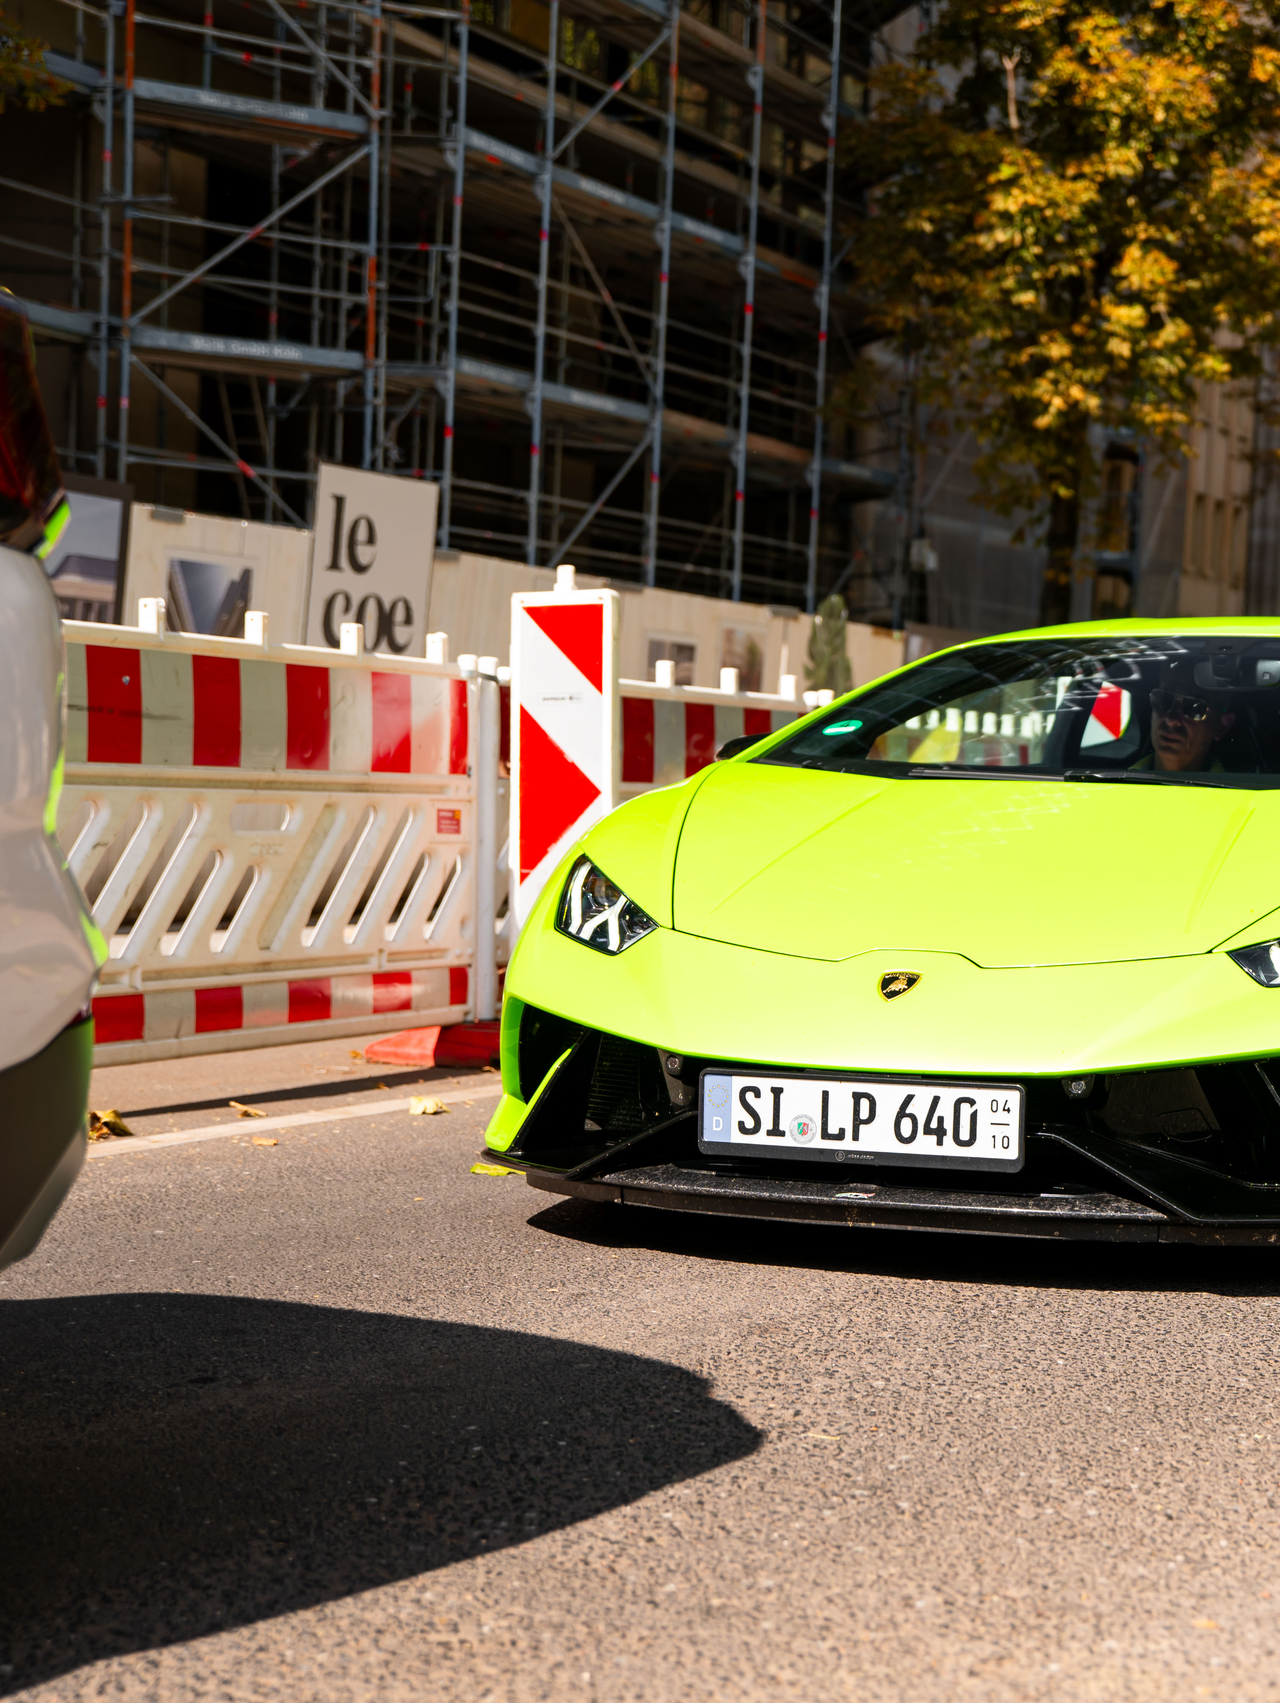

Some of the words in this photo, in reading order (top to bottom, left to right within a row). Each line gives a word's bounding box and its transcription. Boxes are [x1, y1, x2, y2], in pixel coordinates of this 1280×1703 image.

[324, 493, 379, 576] le
[990, 1099, 1011, 1114] 04
[712, 1116, 723, 1131] D
[737, 1085, 786, 1137] SI
[821, 1089, 876, 1141] LP
[893, 1093, 978, 1147] 640
[992, 1135, 1010, 1149] 10
